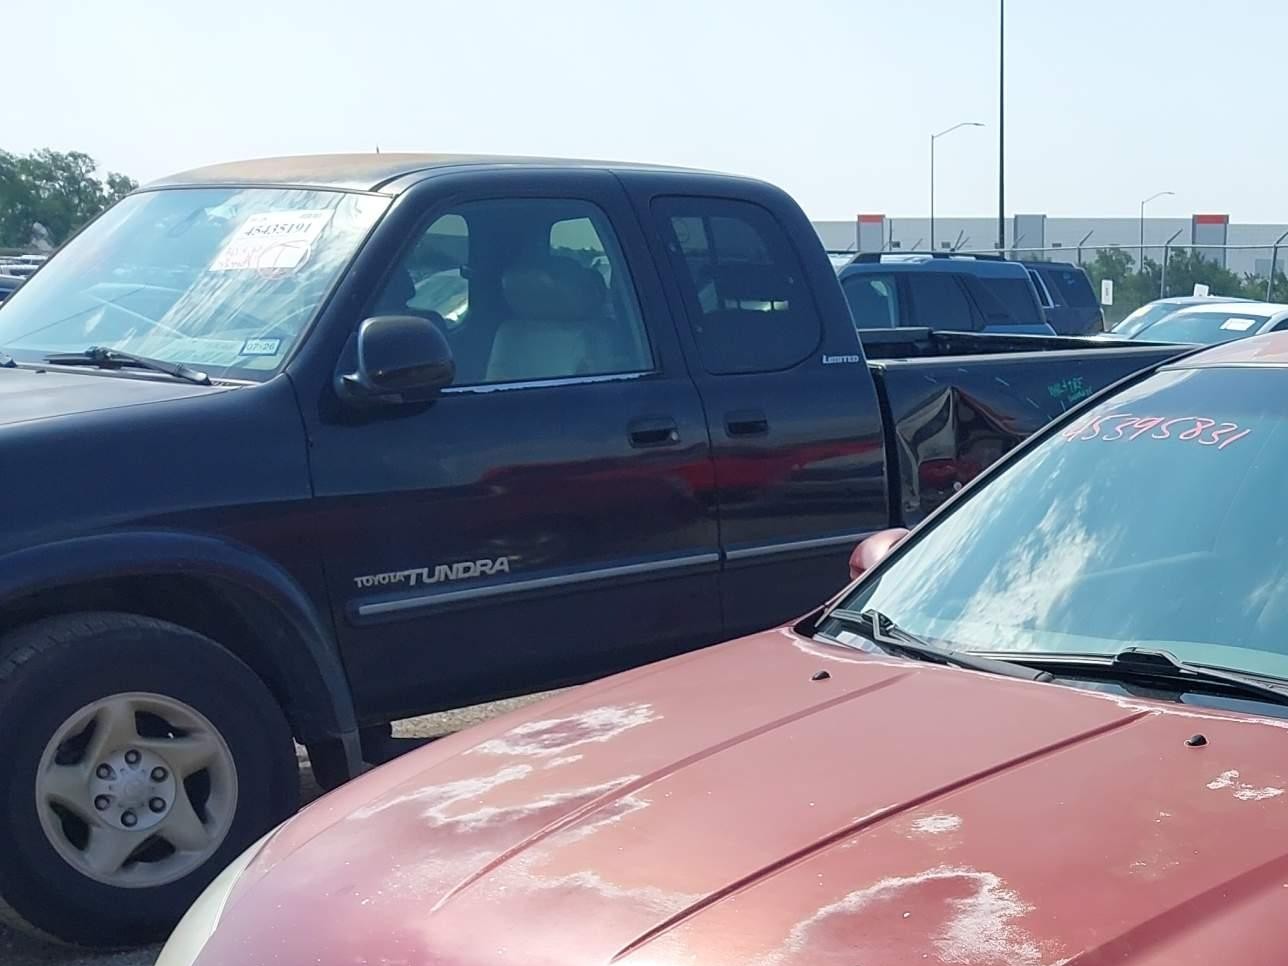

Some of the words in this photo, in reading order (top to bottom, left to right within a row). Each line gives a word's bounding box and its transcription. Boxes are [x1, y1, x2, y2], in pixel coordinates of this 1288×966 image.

[1062, 413, 1252, 451] 45395831
[354, 571, 406, 588] TOYOTA
[403, 556, 510, 586] TUNDRA
